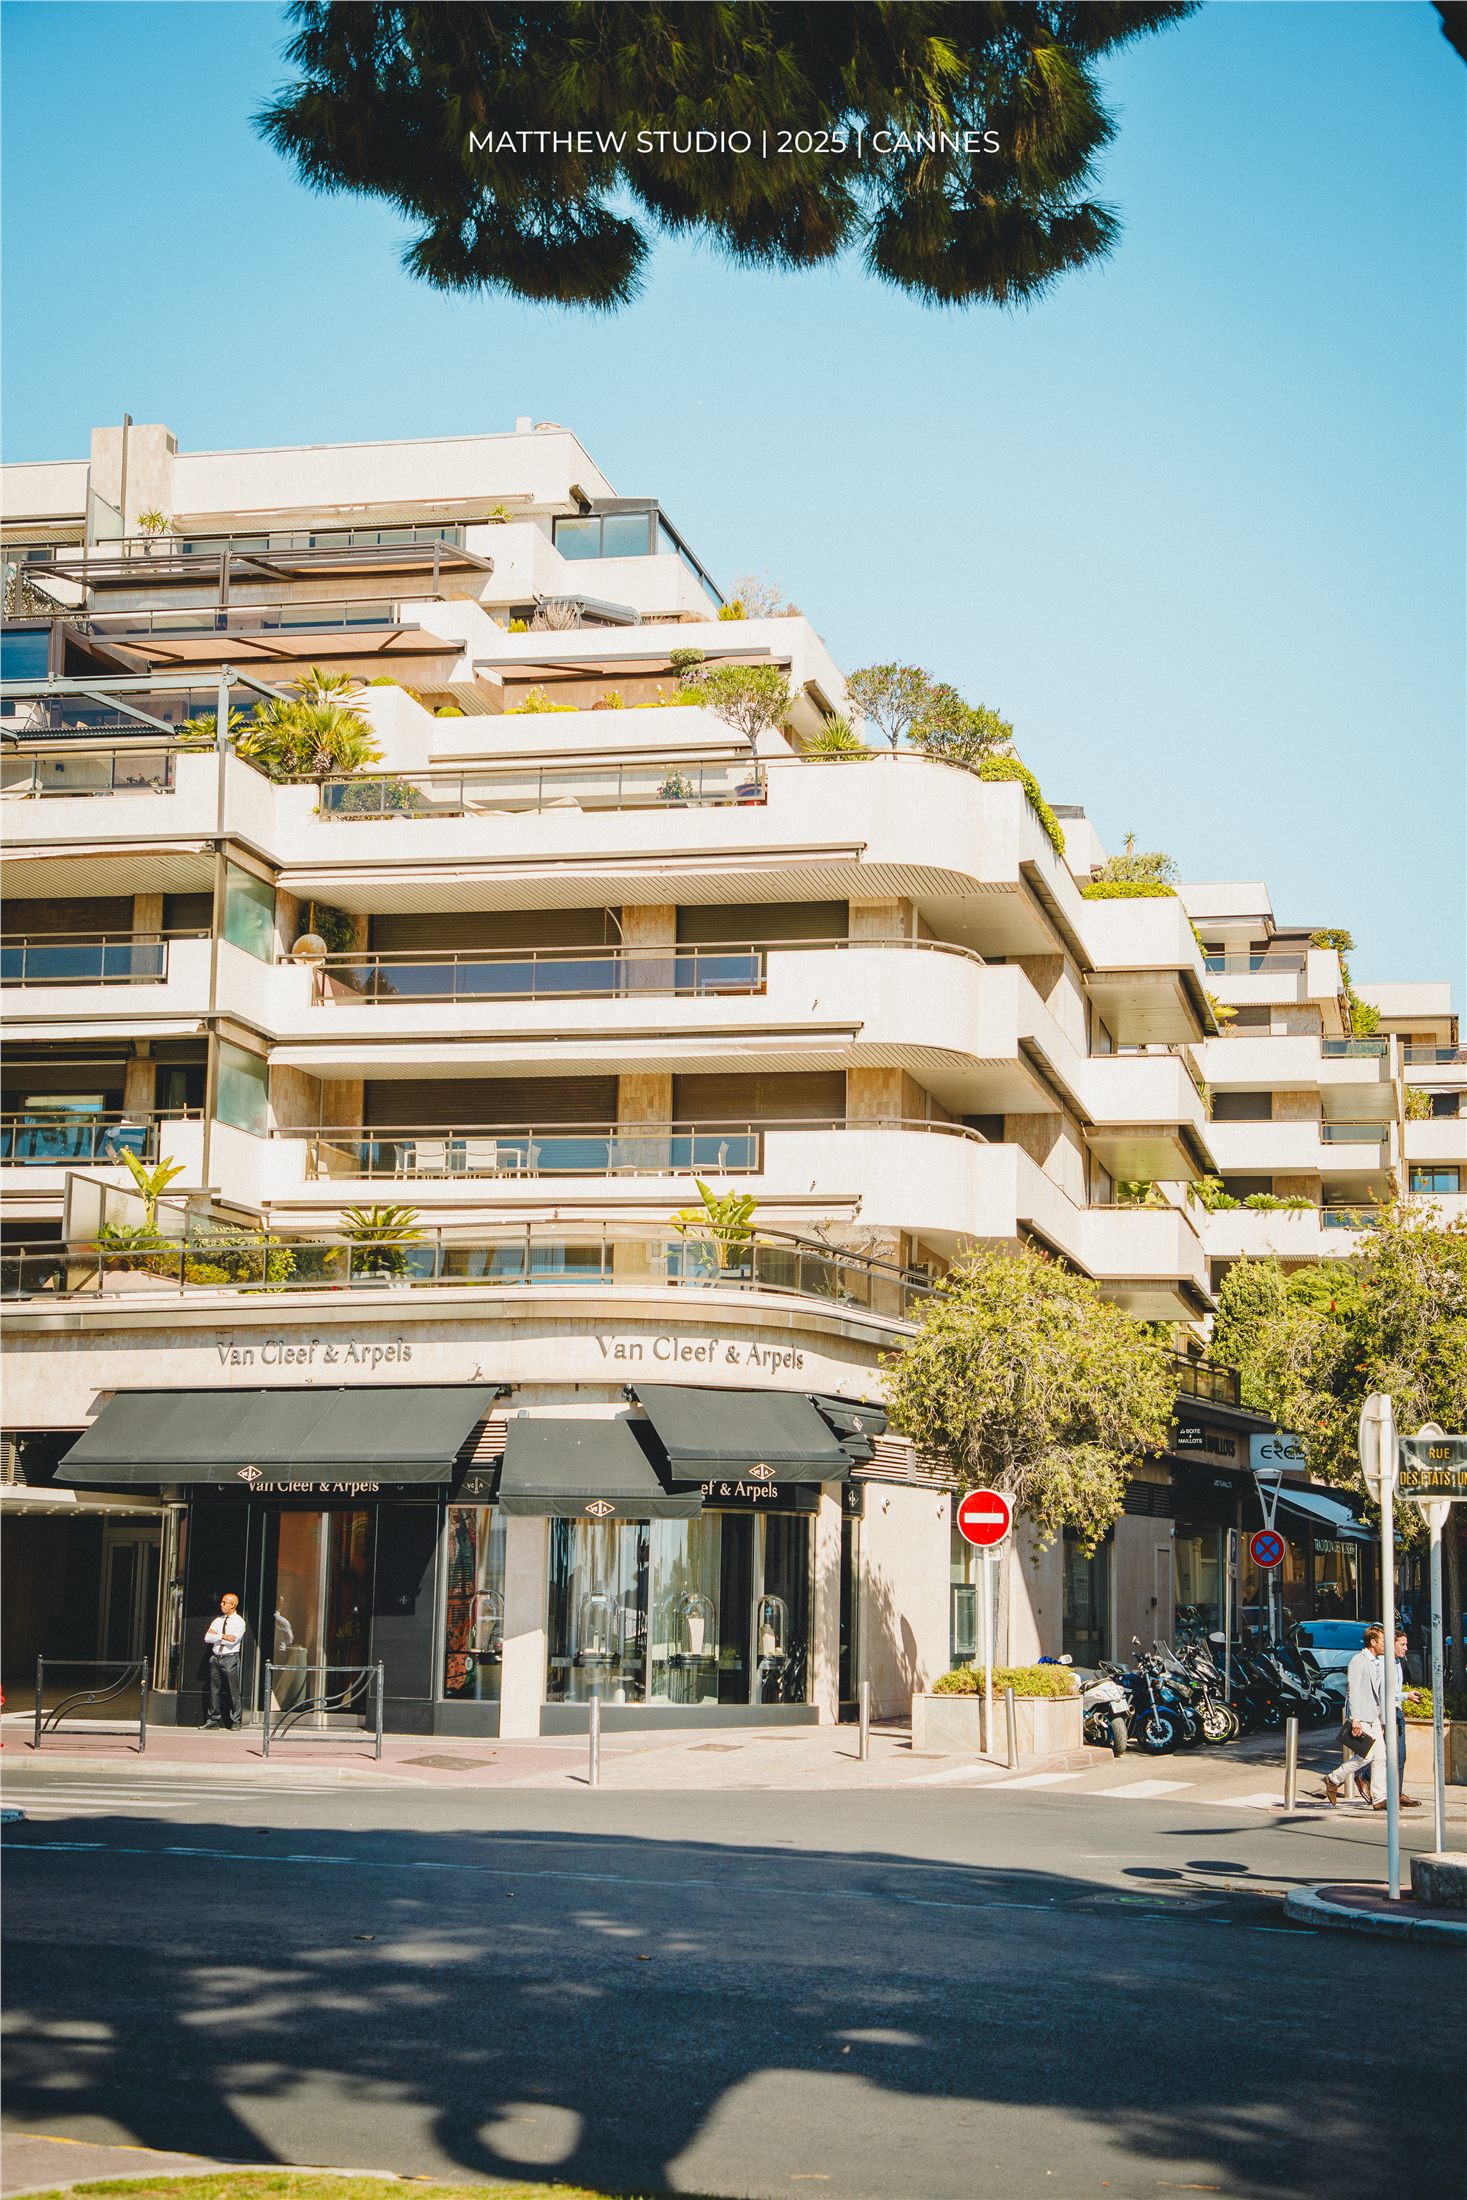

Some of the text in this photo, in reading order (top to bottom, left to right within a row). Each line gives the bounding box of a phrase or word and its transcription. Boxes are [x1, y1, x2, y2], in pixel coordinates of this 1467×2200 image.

[216, 1338, 412, 1370] Van Cleef & Arpels
[595, 1336, 804, 1375] Van Cleef & Arpels
[1428, 1448, 1451, 1459] RUE
[1400, 1472, 1418, 1486] DES
[720, 1482, 731, 1496] &
[735, 1480, 778, 1502] Arpels
